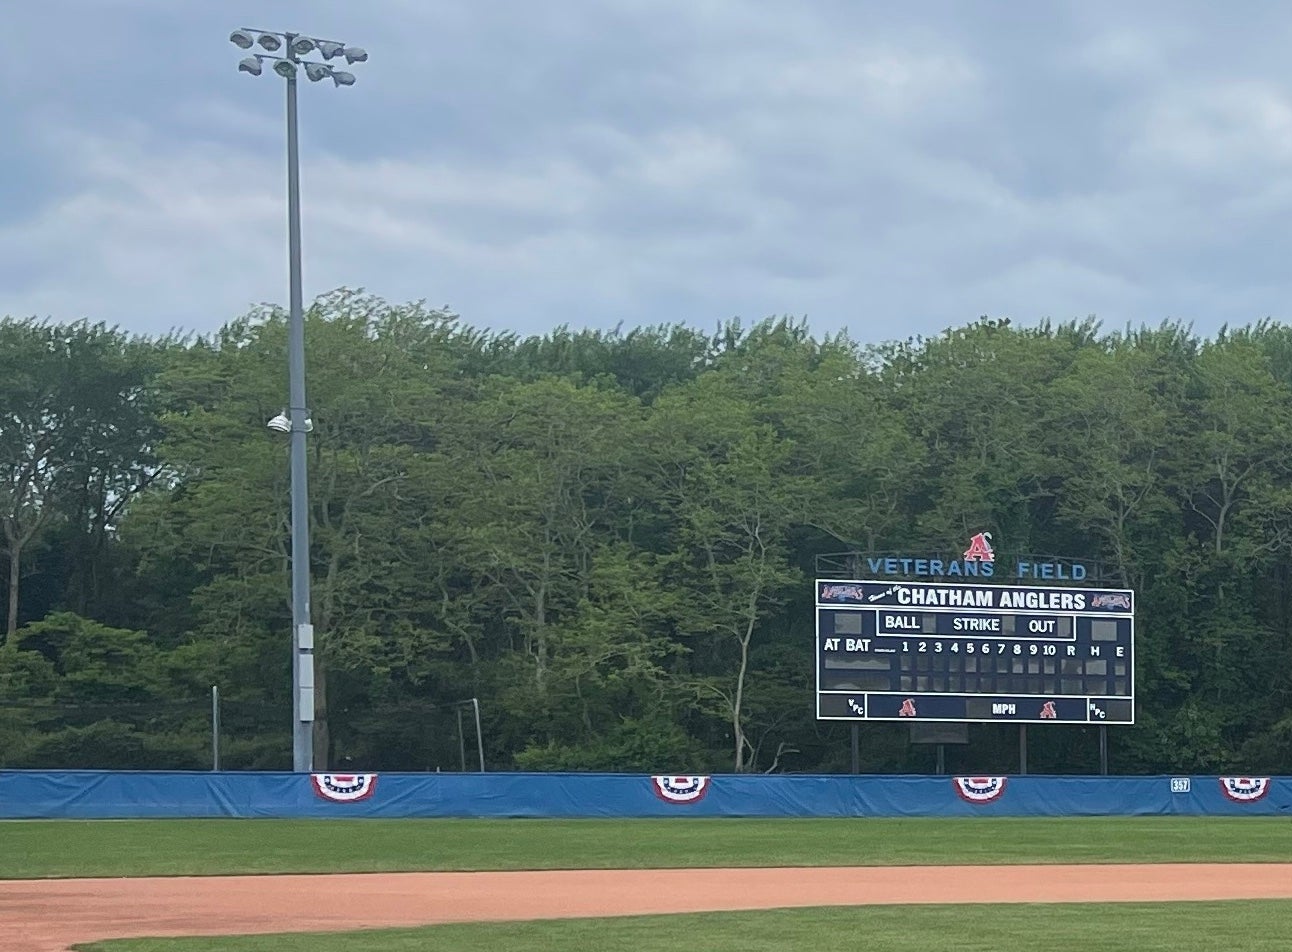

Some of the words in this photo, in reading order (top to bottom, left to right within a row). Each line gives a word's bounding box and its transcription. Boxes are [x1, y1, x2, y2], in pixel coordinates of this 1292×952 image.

[963, 531, 995, 562] A
[867, 557, 994, 577] VETERANS
[1018, 562, 1087, 581] FIELD
[897, 587, 993, 606] CHATHAM
[999, 591, 1086, 610] ANGLERS
[885, 616, 920, 629] BALL
[953, 618, 1000, 631] STRIKE
[1028, 619, 1055, 633] OUT
[824, 638, 841, 651] AT
[845, 639, 871, 652] BAT
[902, 642, 909, 652] 1
[918, 642, 927, 653] 2
[934, 642, 943, 653] 3
[951, 642, 959, 653] 4
[966, 643, 975, 653] 5
[981, 643, 990, 654] 6
[997, 643, 1006, 654] 7
[1013, 644, 1022, 655] 8
[1029, 644, 1038, 655] 9
[1043, 644, 1056, 655] 10
[1067, 645, 1076, 656] R
[1090, 646, 1100, 657] H
[1116, 647, 1124, 657] E
[992, 703, 1016, 715] MPH
